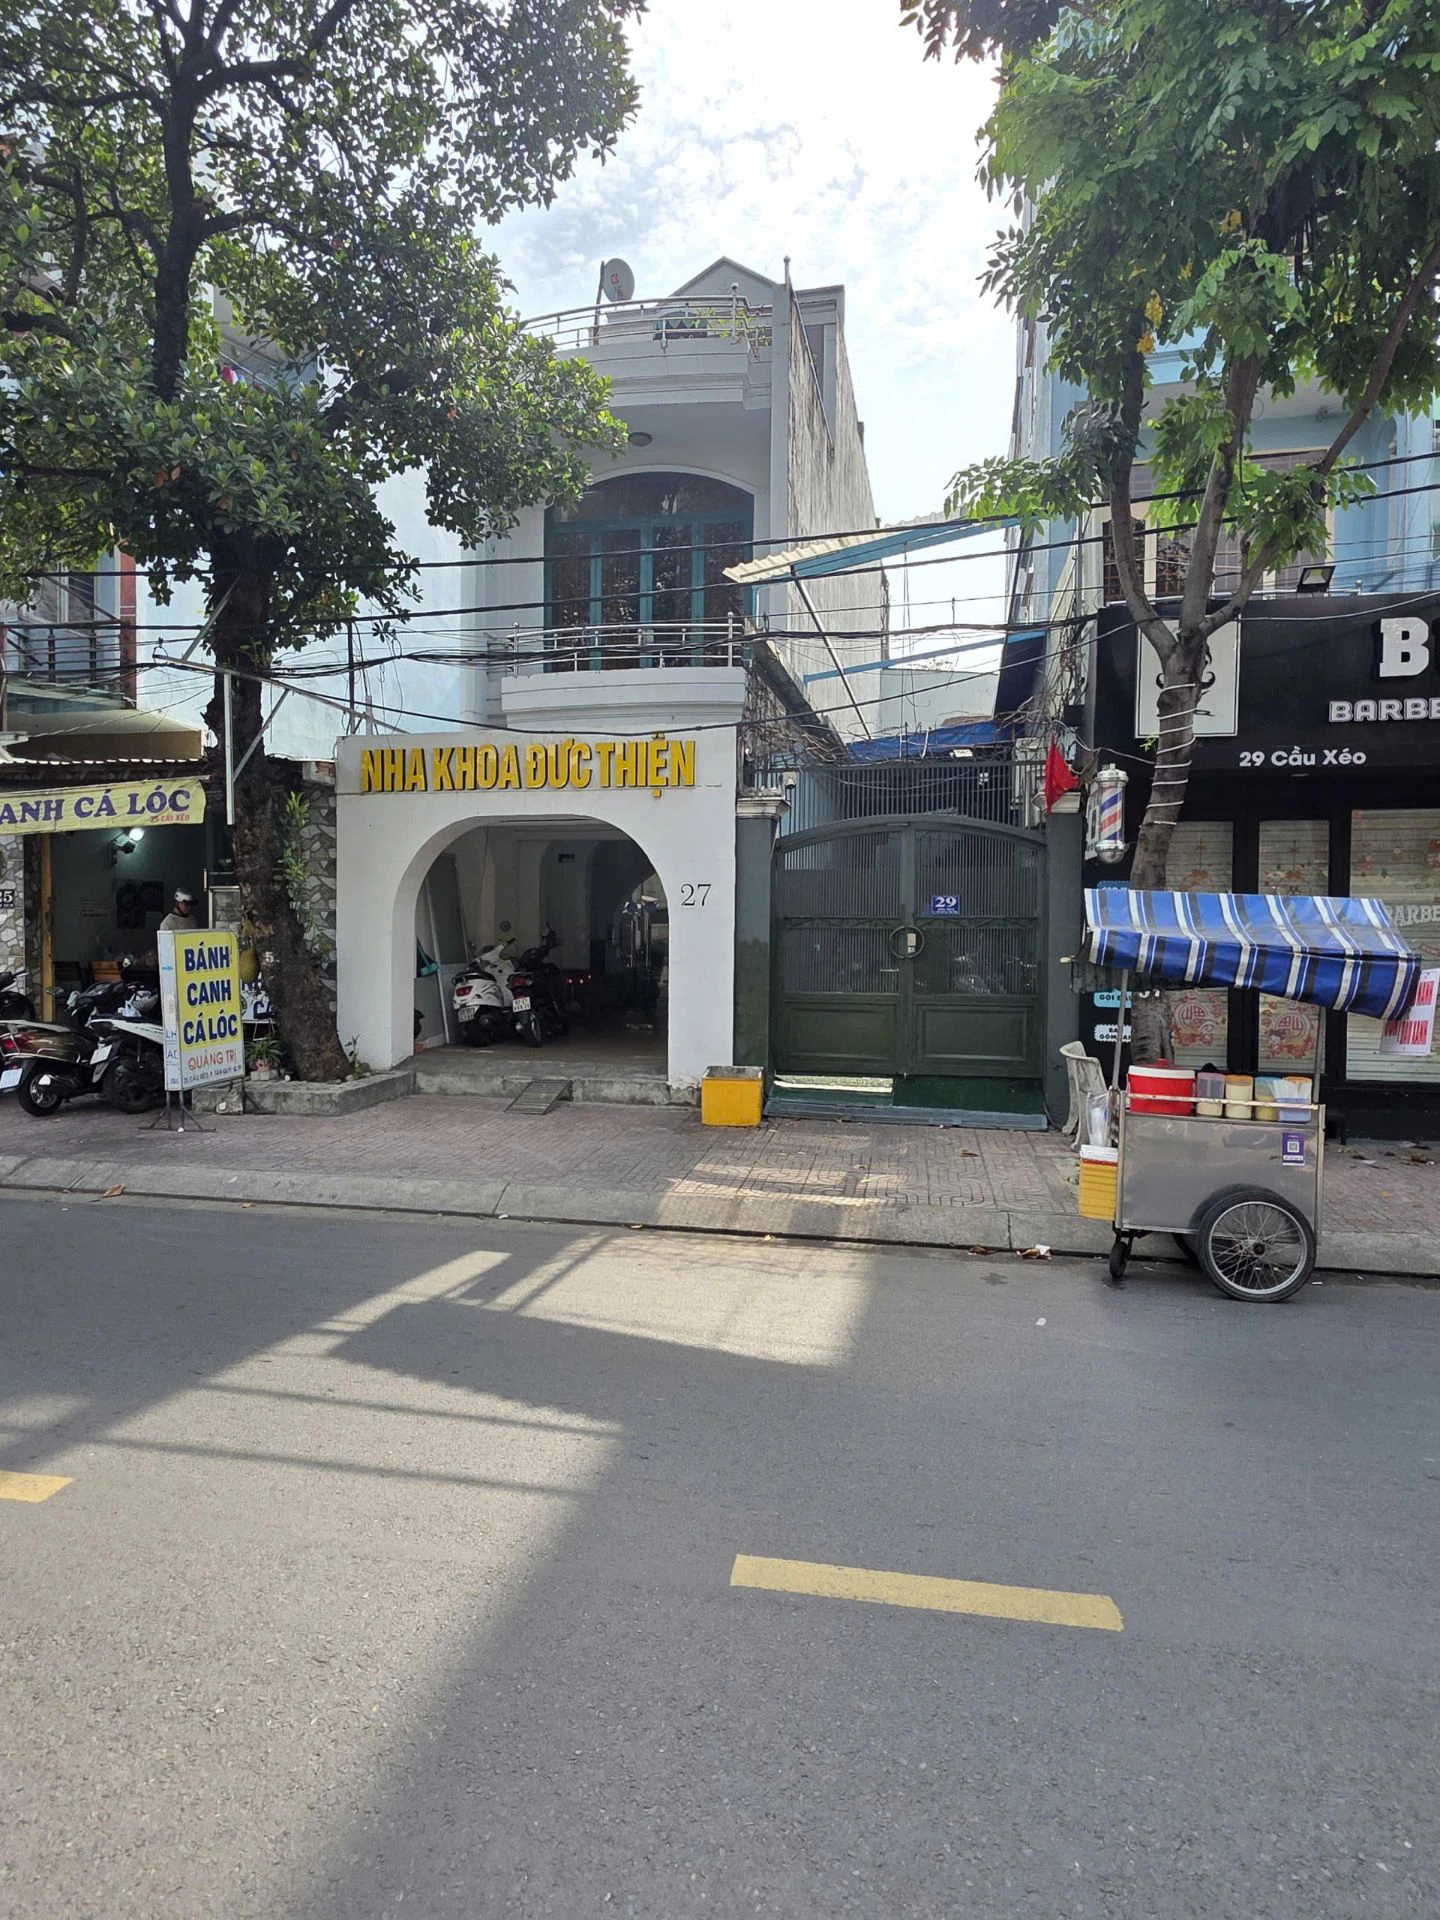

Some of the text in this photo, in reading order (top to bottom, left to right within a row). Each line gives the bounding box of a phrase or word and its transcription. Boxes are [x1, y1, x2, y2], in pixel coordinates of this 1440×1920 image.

[361, 748, 427, 793] NHA
[432, 743, 521, 791] KHOA
[596, 731, 696, 797] THIỆN
[1239, 745, 1367, 767] 29 Cầu Xéo
[74, 789, 117, 819] CÁ
[127, 785, 191, 815] LÓC
[680, 883, 712, 907] 27
[935, 896, 957, 908] 29
[184, 941, 231, 972] BÁNH
[187, 979, 232, 1006] CANH
[183, 1009, 238, 1045] CÁ LÓC
[188, 1049, 224, 1072] QUẢNG
